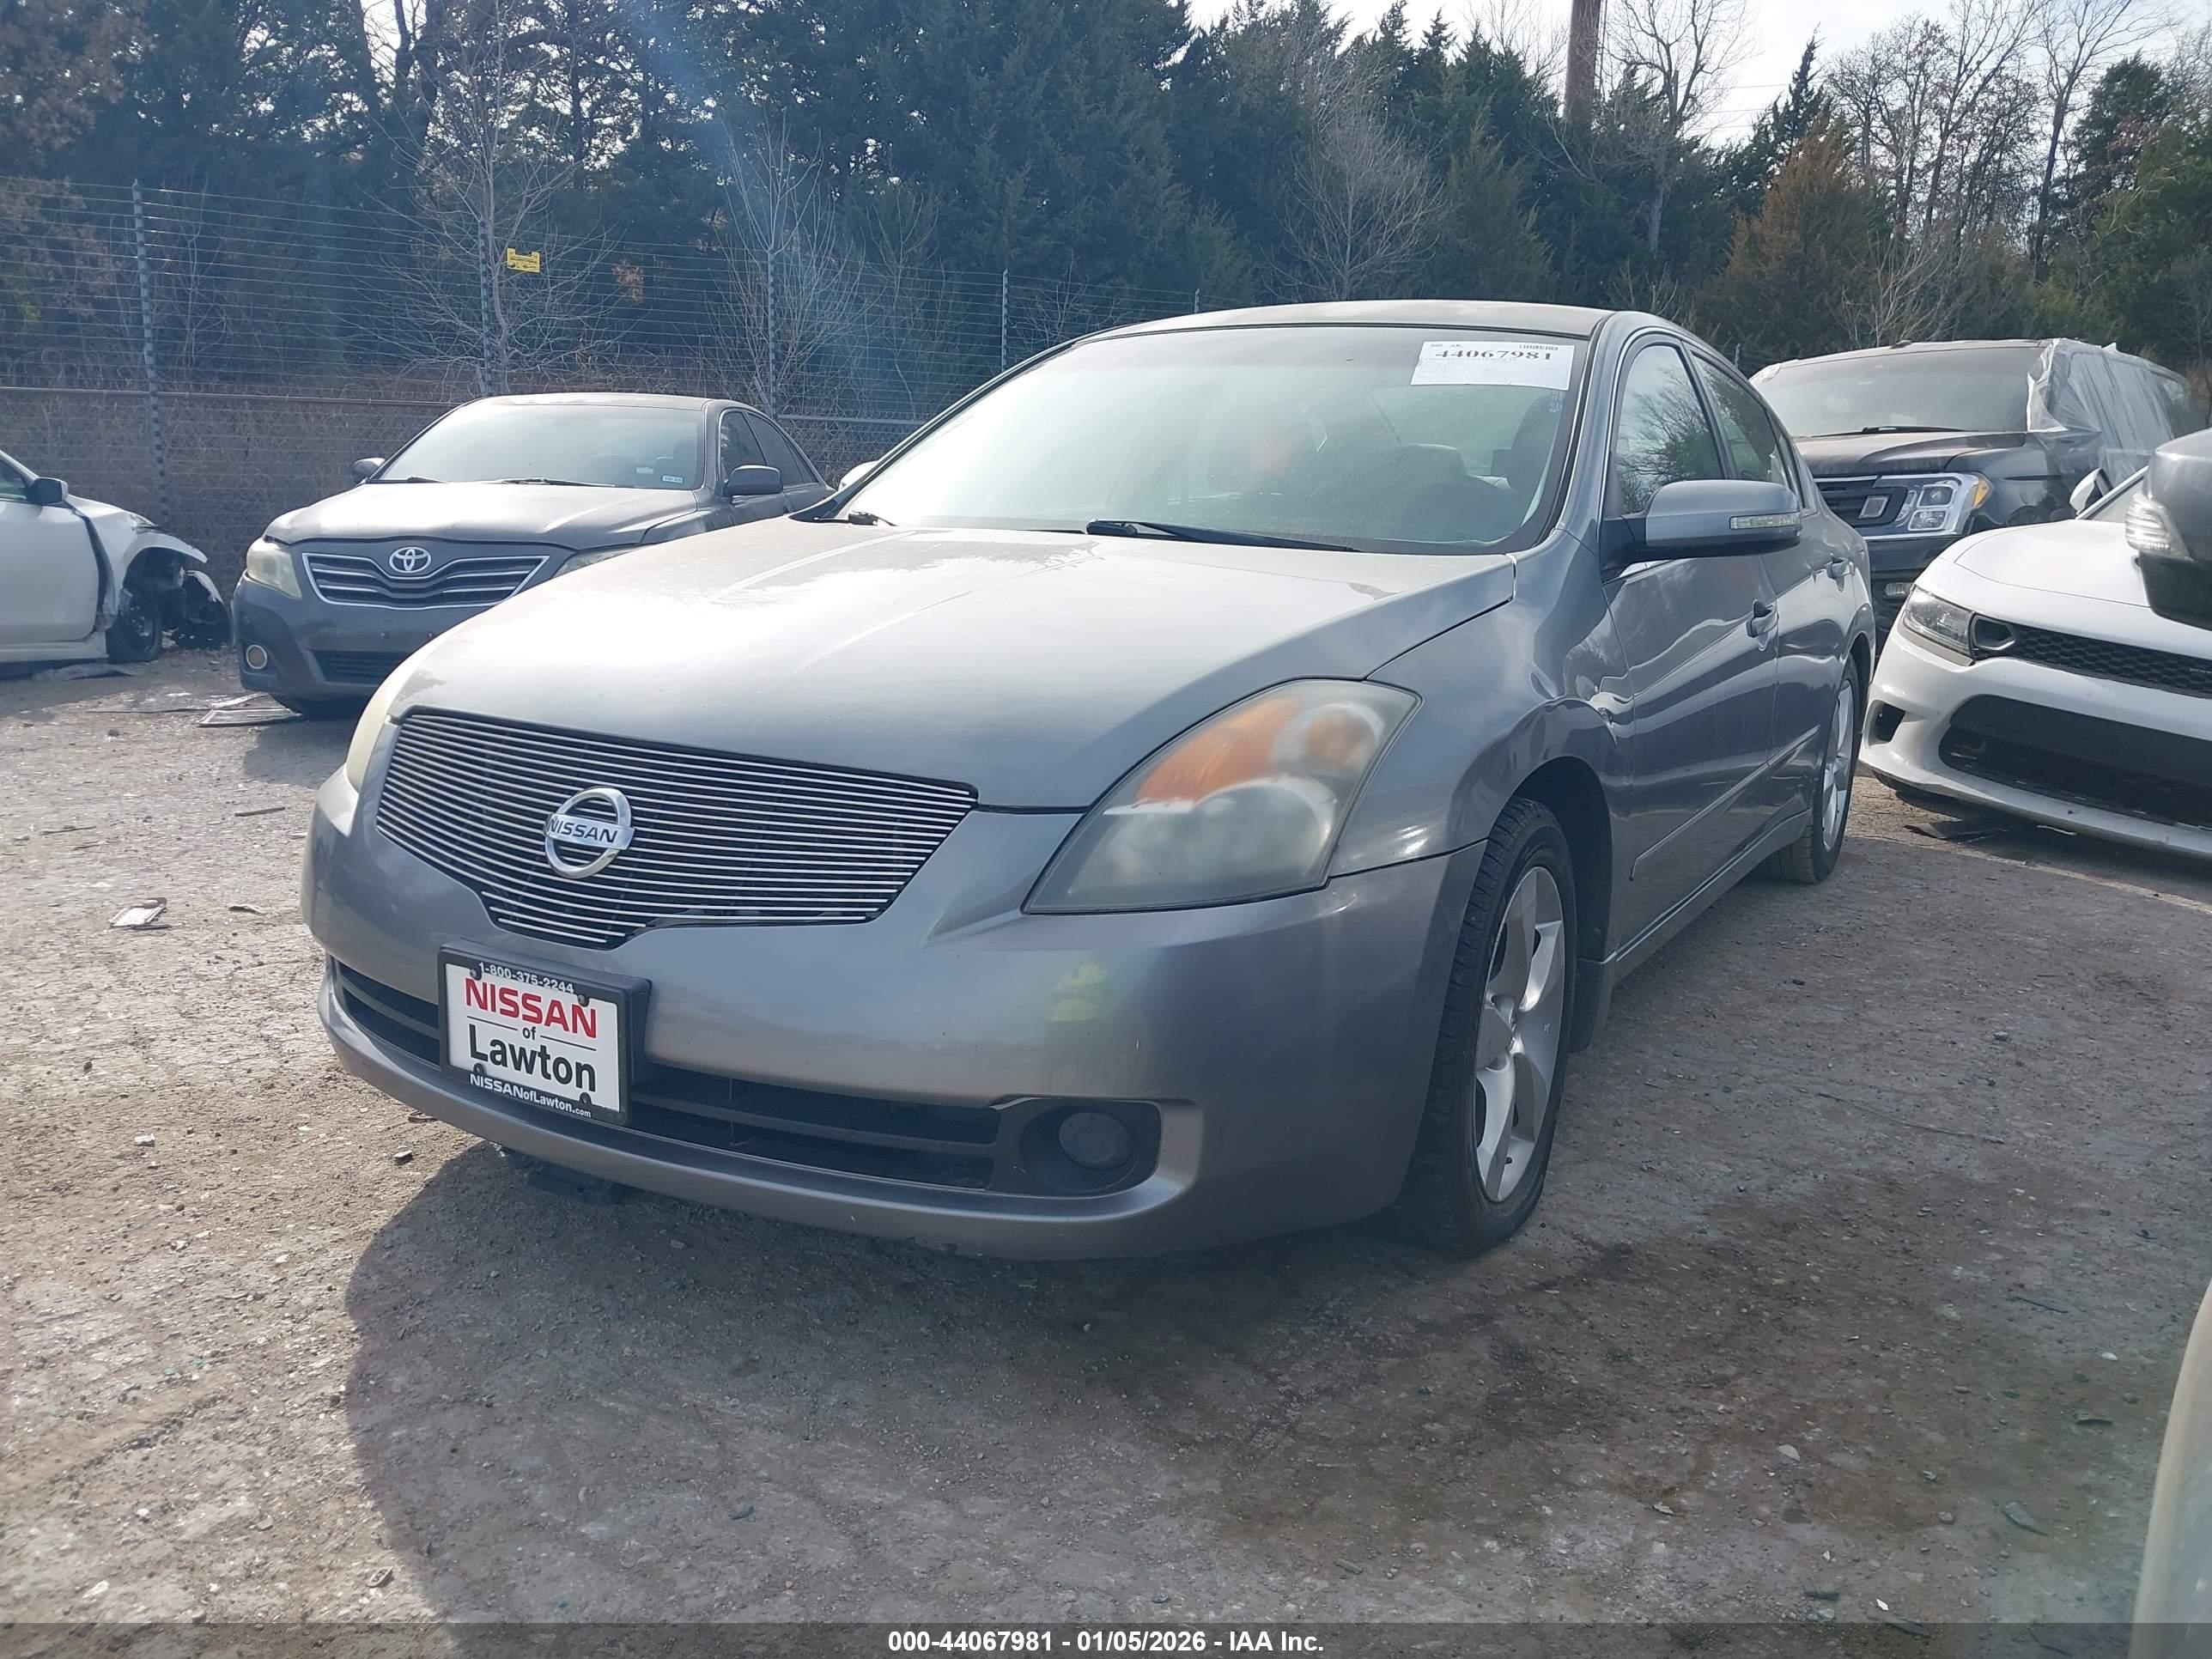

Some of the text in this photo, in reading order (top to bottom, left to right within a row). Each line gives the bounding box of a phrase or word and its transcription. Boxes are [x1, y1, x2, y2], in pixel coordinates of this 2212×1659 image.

[1436, 349, 1552, 360] 44067981
[550, 818, 617, 843] NISSAN
[478, 963, 574, 994] 1-800-375-2244
[465, 977, 597, 1038] NISSAN
[522, 1026, 537, 1040] of
[468, 1024, 596, 1092] Lawton
[470, 1073, 592, 1117] NISSANofLawton.com
